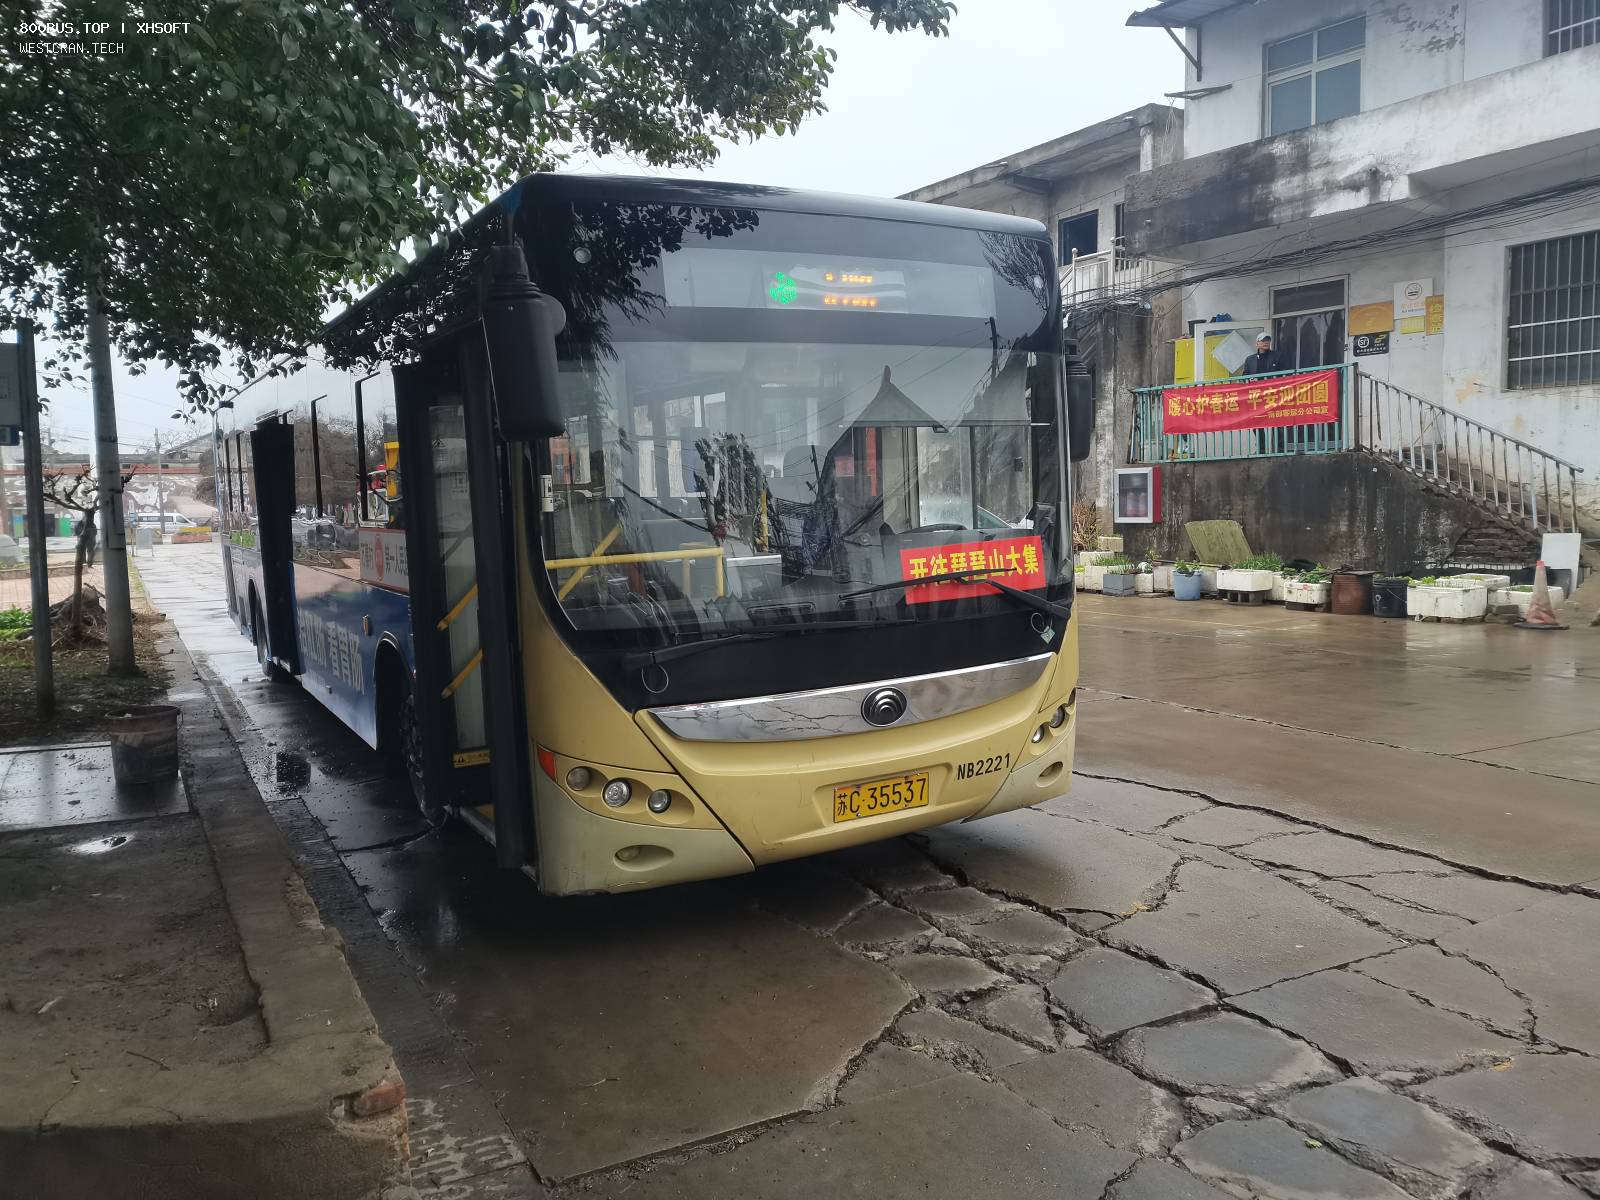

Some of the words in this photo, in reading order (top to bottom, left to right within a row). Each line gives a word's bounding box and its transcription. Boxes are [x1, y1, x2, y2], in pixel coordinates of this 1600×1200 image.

[1167, 392, 1239, 418] 暖心护春运
[1248, 380, 1329, 411] 平安迎团圆
[957, 752, 1011, 781] NB2221
